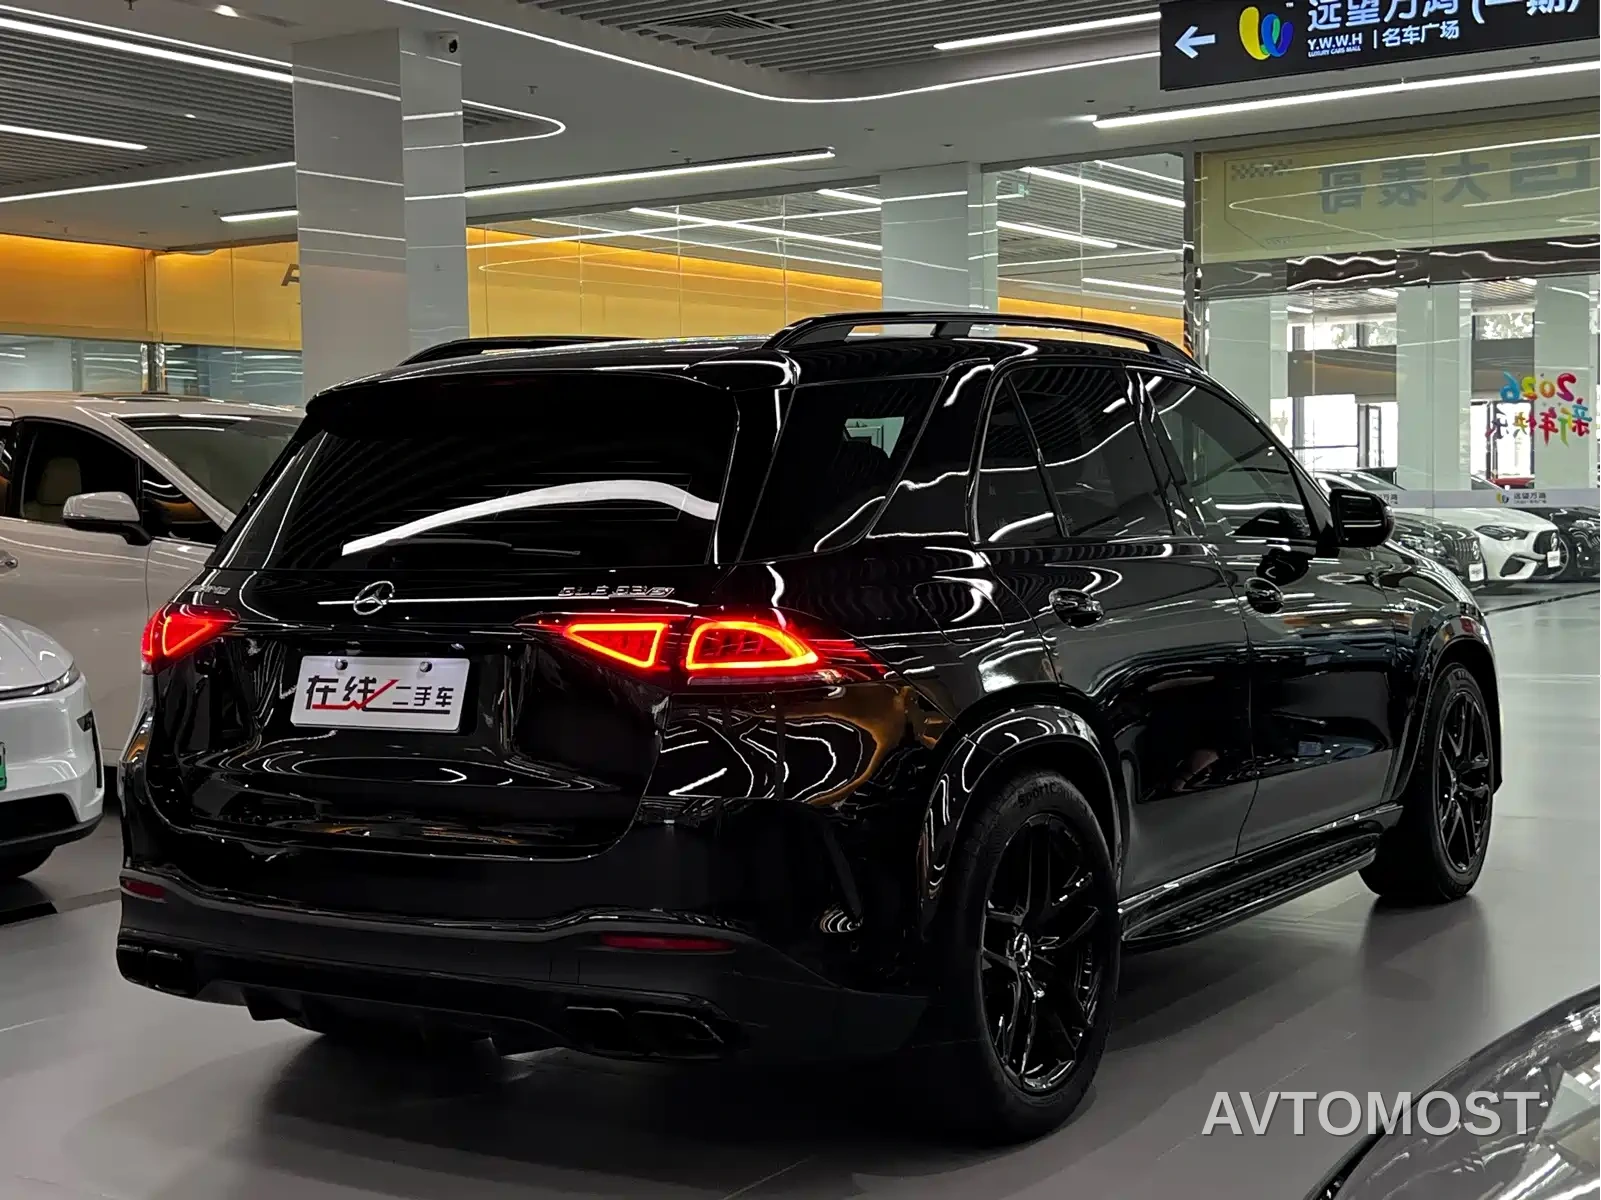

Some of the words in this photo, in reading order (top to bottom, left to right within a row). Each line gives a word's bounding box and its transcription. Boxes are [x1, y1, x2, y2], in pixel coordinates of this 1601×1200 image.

[1307, 33, 1363, 50] Y.W.W.H
[1382, 20, 1460, 47] 名车广场
[305, 675, 399, 710] 在线
[392, 686, 455, 707] 二手车
